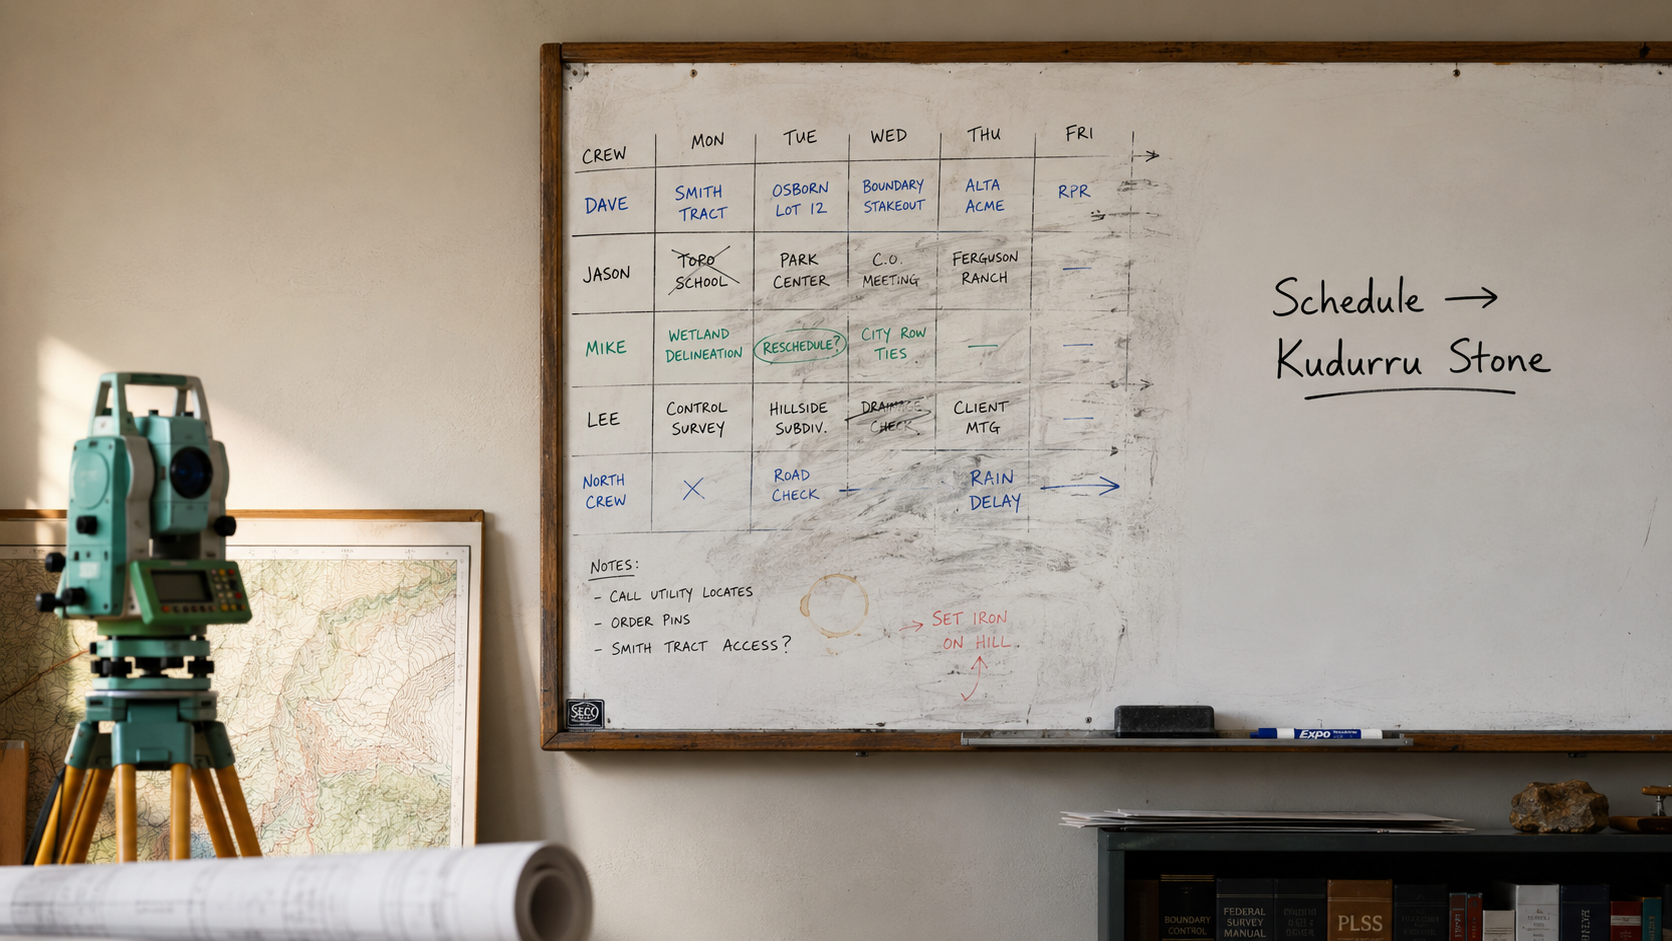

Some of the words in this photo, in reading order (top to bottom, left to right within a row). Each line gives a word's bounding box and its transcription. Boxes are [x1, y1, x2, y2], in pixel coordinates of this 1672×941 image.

[691, 132, 724, 149] MON
[783, 129, 818, 146] TUE
[871, 128, 907, 143] WED
[967, 126, 1001, 143] THU
[1065, 125, 1093, 141] FRI
[582, 146, 626, 164] CREW
[675, 184, 722, 201] SMITH
[772, 181, 829, 197] OSBORN
[862, 178, 924, 194] BOUNDARY
[965, 178, 1000, 192] ALTA
[1058, 185, 1091, 199] RPR
[585, 196, 629, 214] DAVE
[775, 203, 801, 217] LOT
[810, 202, 827, 215] 12
[864, 199, 926, 213] STAKEOUT
[965, 200, 1005, 213] ACME
[679, 206, 728, 221] TRACT
[780, 252, 819, 268] PARK
[872, 252, 903, 267] C.O.
[952, 250, 1019, 267] FERGUSON
[583, 266, 630, 284] JASON
[676, 276, 728, 290] SCHOOL
[773, 275, 830, 289] CENTER
[863, 274, 920, 288] MEETING
[961, 271, 1008, 285] RANCH
[1273, 275, 1424, 317] Schedule
[668, 328, 730, 342] WETLAND
[861, 327, 891, 344] CITY
[585, 340, 627, 357] MIKE
[763, 335, 841, 355] RESCHEDULE?
[665, 346, 743, 363] DELINEATION
[874, 347, 907, 360] TIES
[1277, 338, 1422, 379] Kudurru
[1450, 337, 1551, 374] Stone
[666, 401, 728, 416] CONTROL
[769, 401, 828, 416] HILLSIDE
[954, 400, 1009, 415] CLIENT
[587, 412, 621, 428] LEE
[966, 421, 1001, 435] MTG
[672, 421, 725, 438] SURVEY
[775, 422, 828, 435] SUBDIV.
[582, 473, 625, 489] NORTH
[774, 468, 810, 483] ROAD
[970, 469, 1014, 486] RAIN
[585, 494, 626, 509] CREW
[771, 488, 820, 502] CHECK
[969, 493, 1021, 513] DELAY
[590, 559, 639, 575] NOTES:
[609, 590, 641, 603] CALL
[651, 588, 693, 603] UTILITY
[702, 586, 754, 598] LOCATES
[611, 616, 654, 629] ORDER
[663, 614, 691, 626] PINS
[932, 610, 964, 627] SET
[973, 610, 1007, 625] IRON
[611, 642, 652, 656] SMITH
[664, 640, 708, 653] TRACT
[722, 635, 792, 654] ACCESS?
[943, 635, 963, 650] ON
[976, 634, 1011, 649] HILL
[1164, 915, 1211, 924] BOUNDARY
[1223, 907, 1266, 916] FEDERAL
[1168, 926, 1207, 935] CONTROL
[1227, 918, 1264, 927] SURVEY
[1338, 914, 1383, 932] PLSS
[1224, 929, 1266, 938] MANUAL
